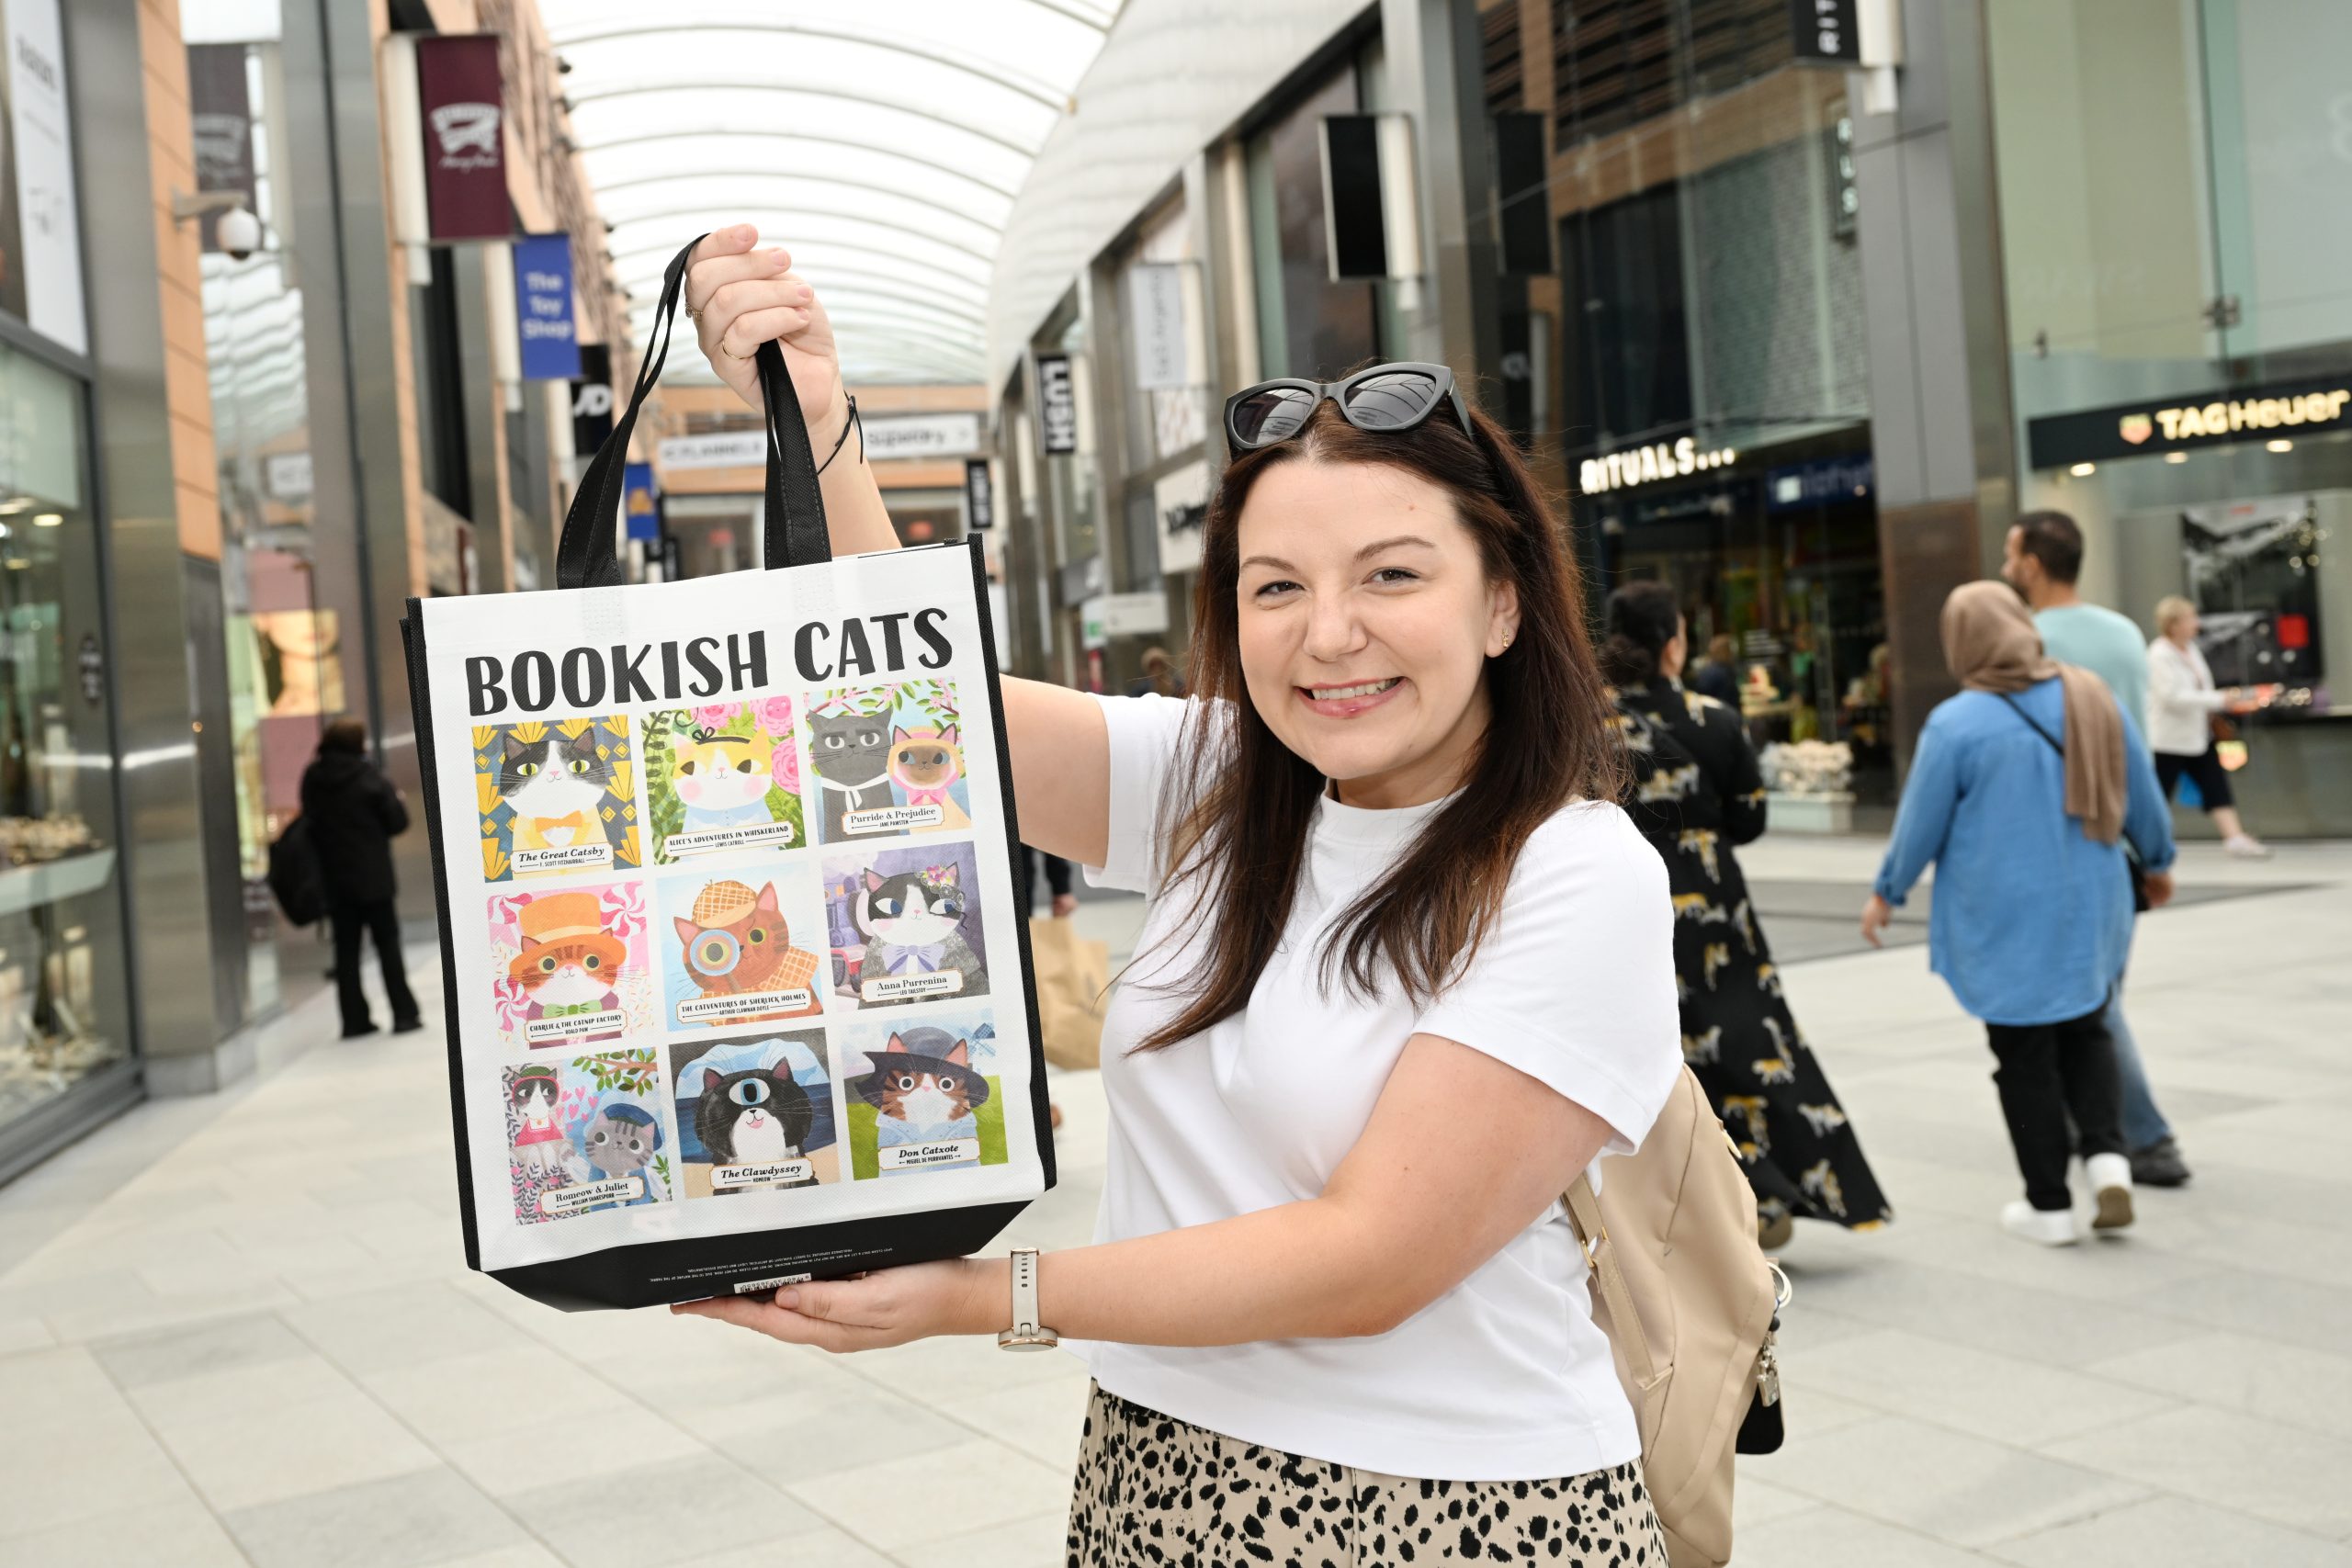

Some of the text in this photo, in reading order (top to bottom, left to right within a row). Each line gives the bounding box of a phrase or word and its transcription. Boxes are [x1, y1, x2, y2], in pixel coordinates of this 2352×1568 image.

[526, 274, 562, 292] The
[529, 294, 563, 318] Toy
[522, 320, 572, 341] Shop
[573, 383, 614, 416] JD
[1042, 361, 1074, 450] LUSH
[465, 607, 954, 716] BOOKISH CATS
[851, 813, 884, 823] Purride
[895, 808, 936, 818] Prejudice
[669, 838, 692, 846] ALICE'S
[694, 833, 733, 842] ADVENTURES
[744, 826, 788, 837] WHISKERLAND
[519, 847, 605, 862] The Great Catsby
[876, 976, 947, 991] Anna Purrenina
[695, 1000, 738, 1011] CATVENTURES
[781, 993, 806, 1001] HOLMES
[718, 1008, 736, 1016] ARTHUR
[529, 1022, 554, 1032] CHARLIE
[573, 1018, 595, 1026] CATNIP
[596, 1014, 622, 1023] FACTORY
[899, 1145, 959, 1158] Don Catxote
[721, 1165, 802, 1179] The Clawdyssey
[555, 1182, 628, 1202] Romeow & Juliet
[571, 1197, 588, 1206] WILLIAM
